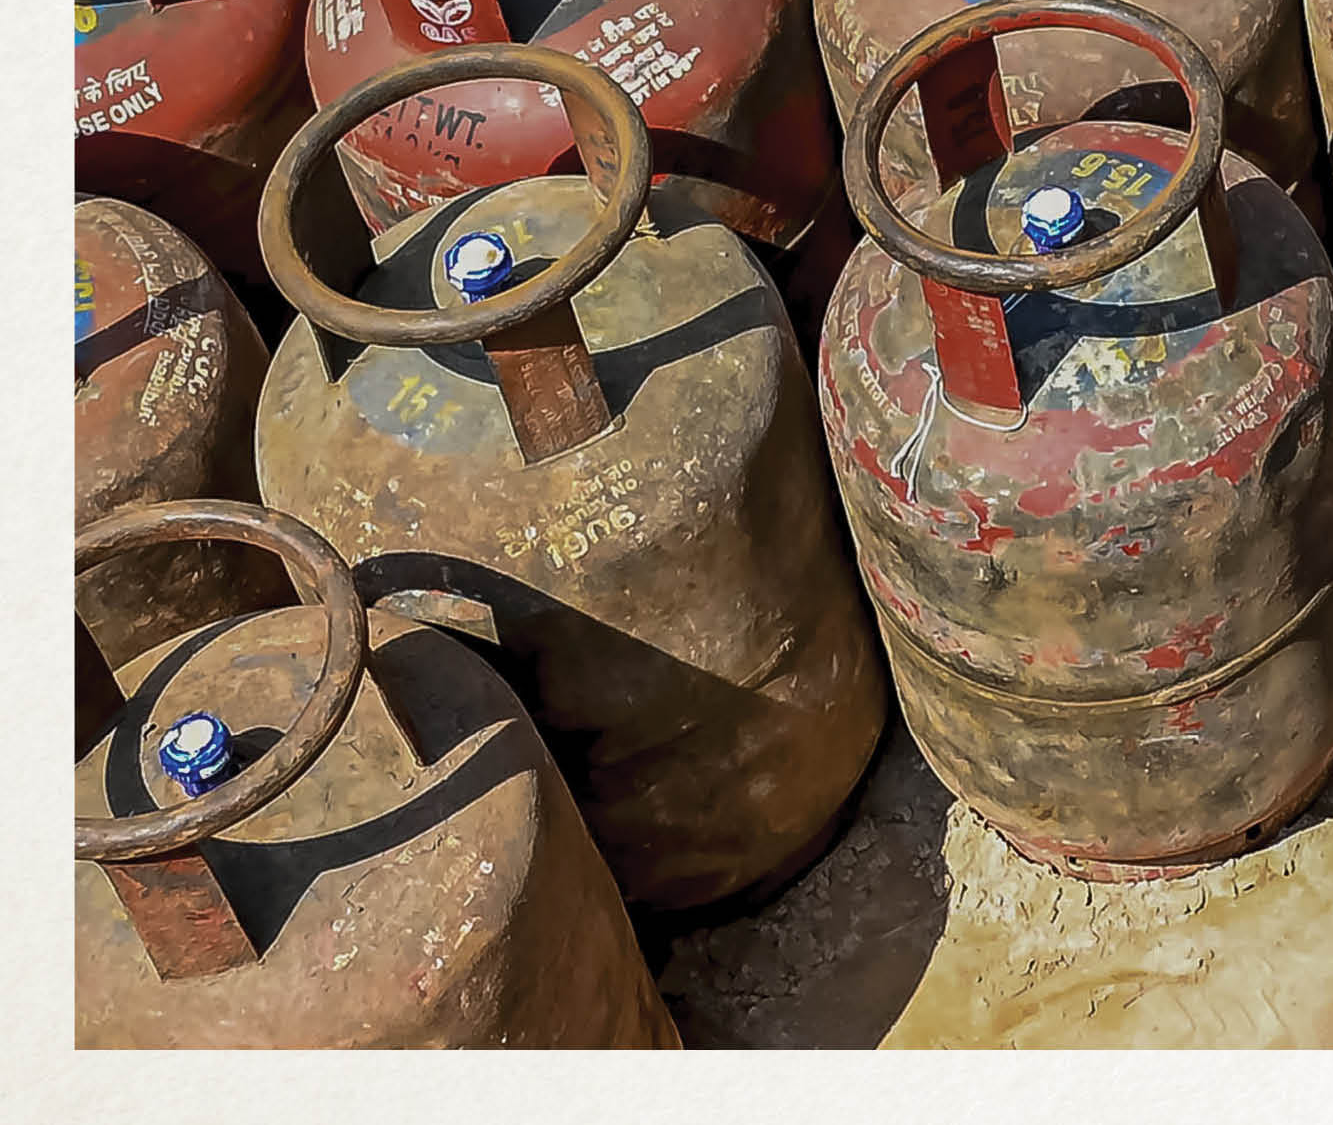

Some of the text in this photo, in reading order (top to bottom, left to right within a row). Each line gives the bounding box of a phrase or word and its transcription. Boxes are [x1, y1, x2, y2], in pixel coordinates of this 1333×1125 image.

[82, 59, 151, 104] के लिए
[108, 82, 164, 125] ONLY
[434, 103, 488, 149] WT.
